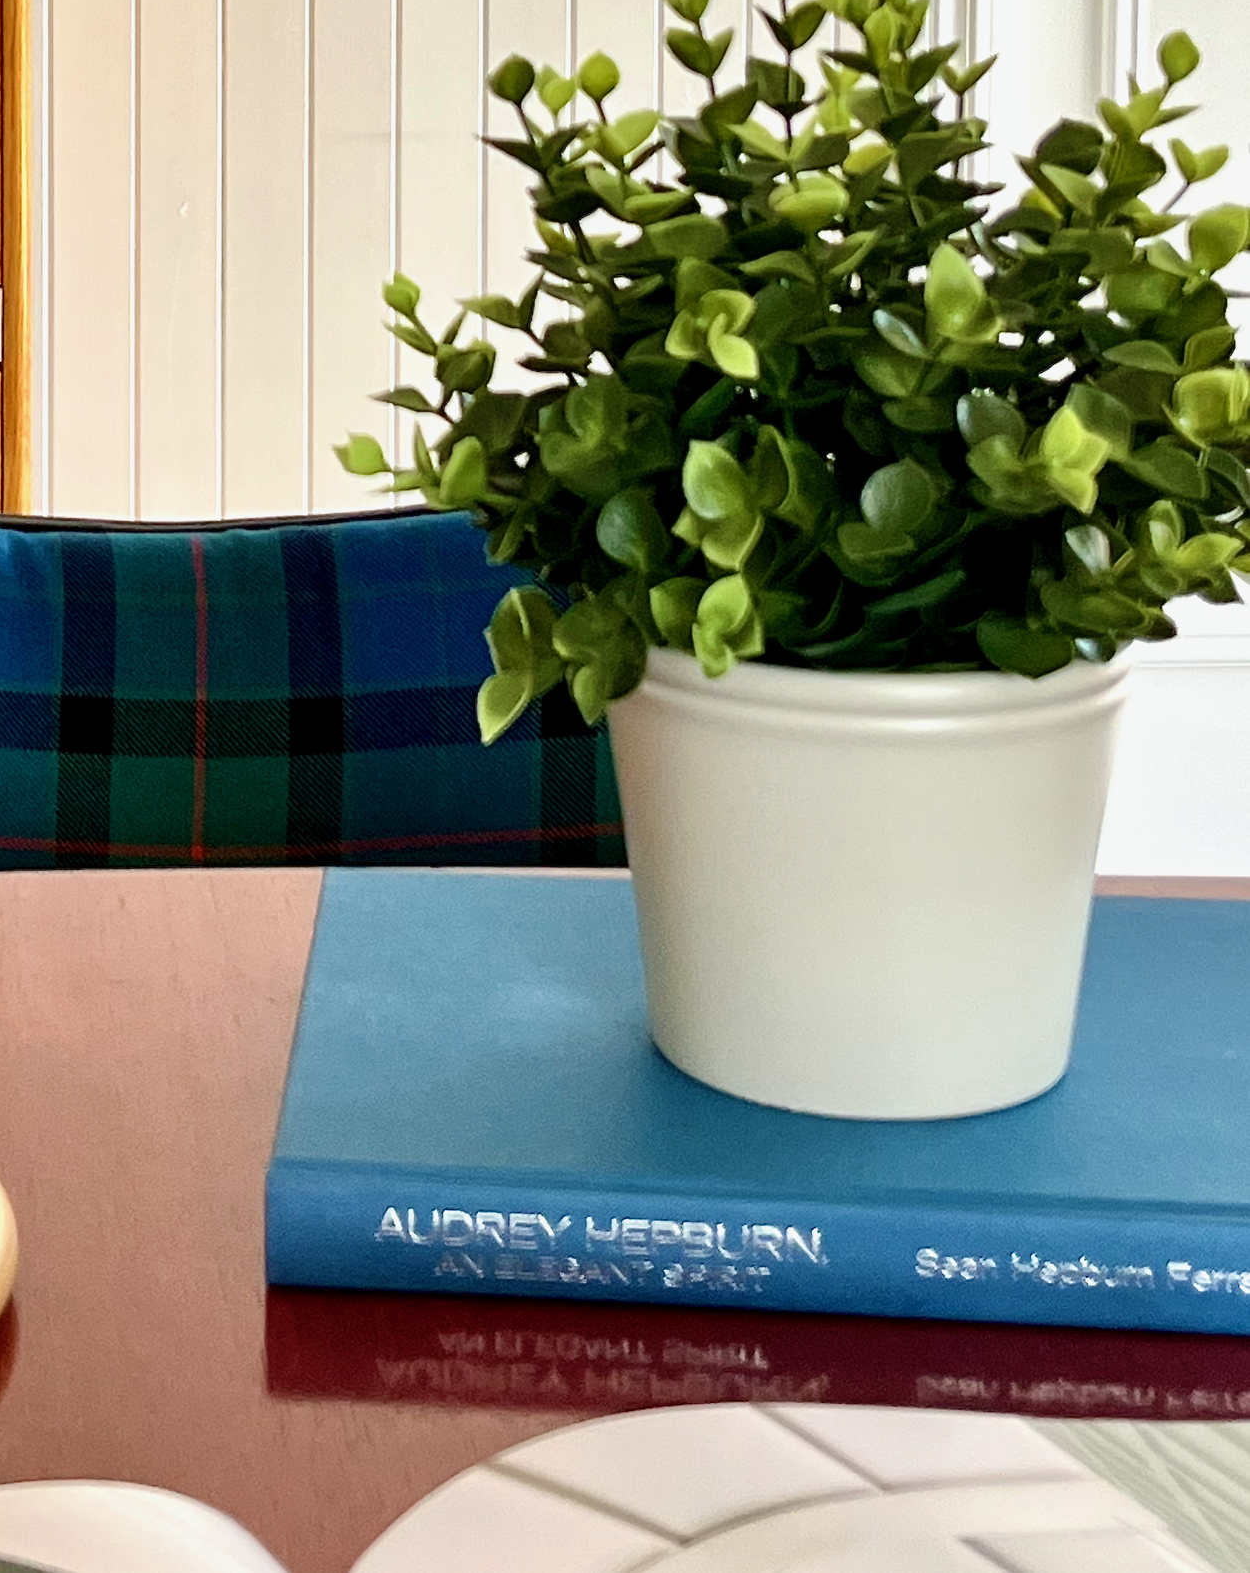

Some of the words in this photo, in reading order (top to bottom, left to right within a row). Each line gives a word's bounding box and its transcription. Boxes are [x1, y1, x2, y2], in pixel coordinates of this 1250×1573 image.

[374, 1206, 570, 1249] AUDREY
[434, 1253, 485, 1279] AN
[494, 1254, 657, 1286] ELEGANT
[662, 1263, 770, 1294] SPIRIT
[914, 1247, 997, 1281] Sean
[1010, 1252, 1153, 1293] Hepburn
